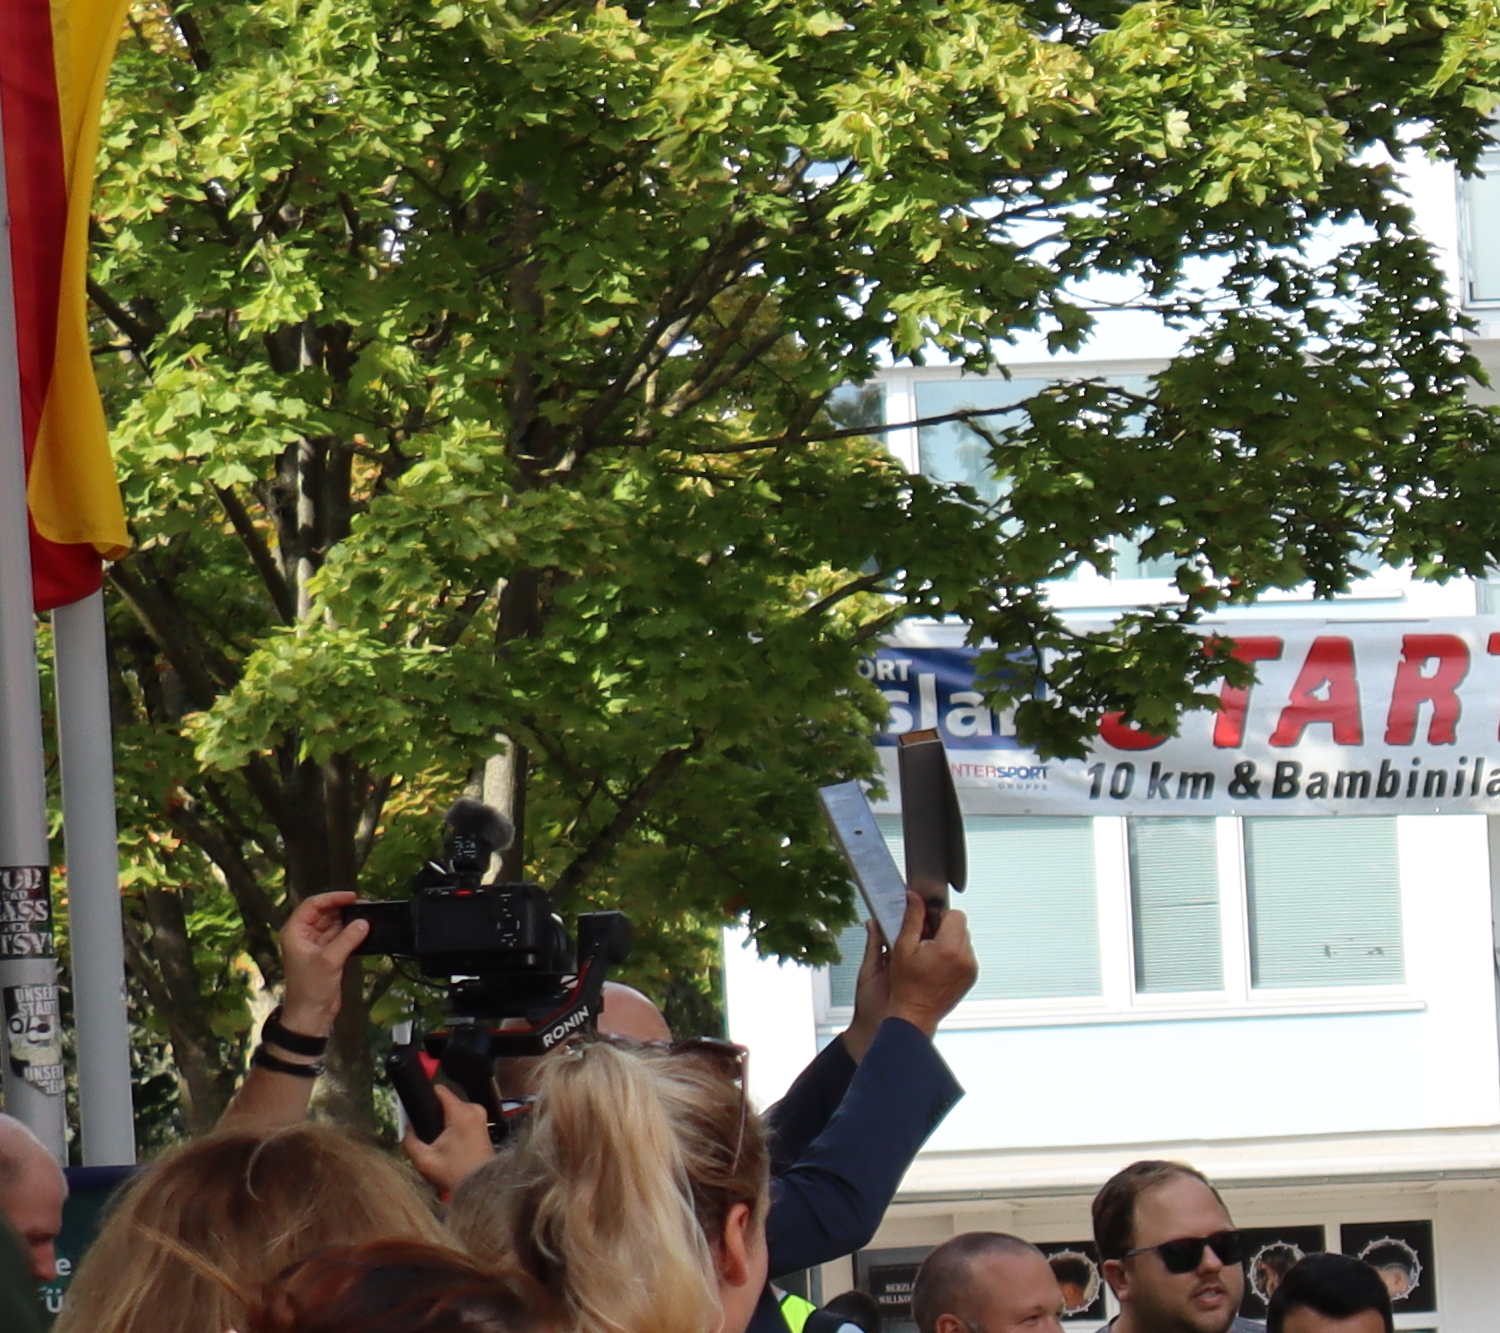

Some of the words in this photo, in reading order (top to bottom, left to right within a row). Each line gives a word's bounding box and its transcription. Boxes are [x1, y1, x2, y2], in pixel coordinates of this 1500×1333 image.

[858, 659, 913, 681] ORT
[881, 672, 1018, 737] slar
[950, 763, 1048, 780] NTERSPORT
[1087, 761, 1135, 799] 10
[1148, 761, 1216, 799] km
[1227, 761, 1261, 799] &
[998, 783, 1048, 791] GRUPPE
[543, 1005, 590, 1047] RONIN
